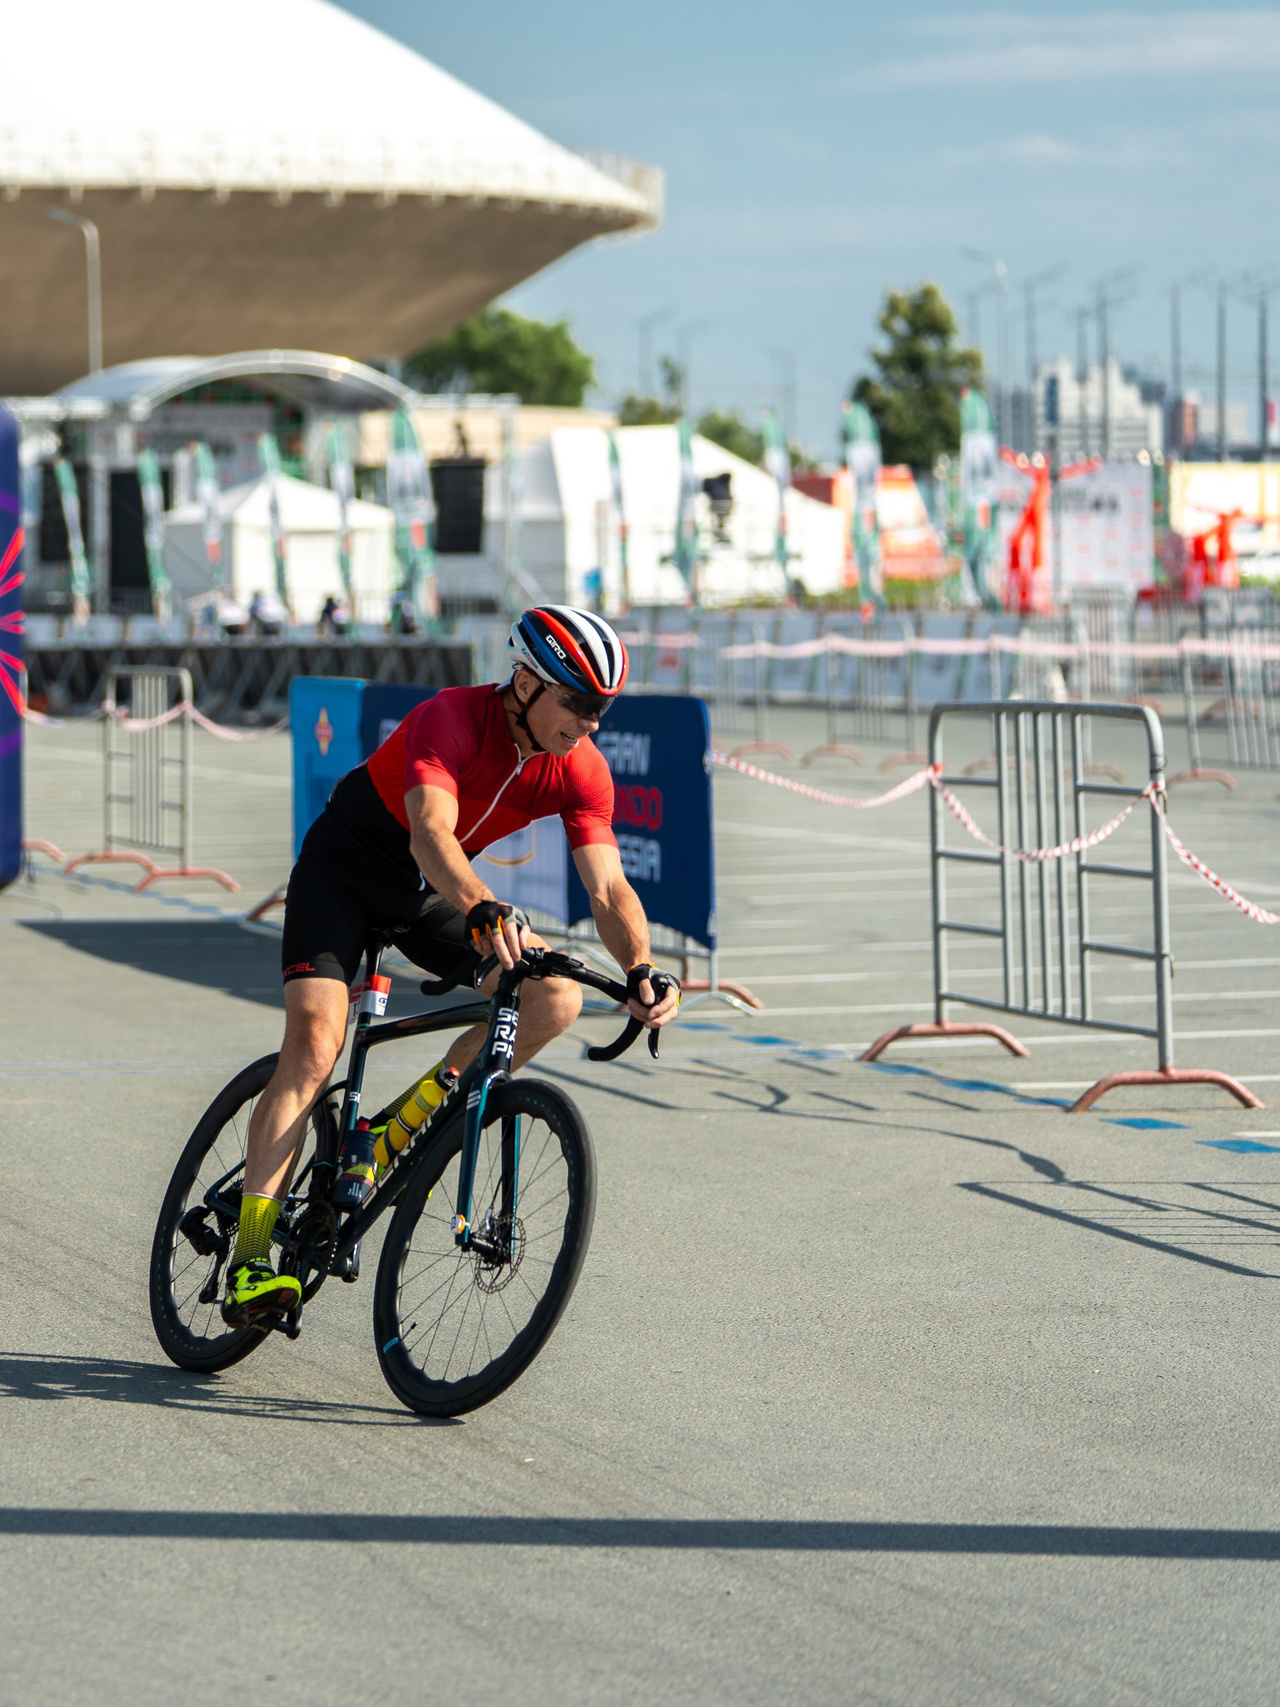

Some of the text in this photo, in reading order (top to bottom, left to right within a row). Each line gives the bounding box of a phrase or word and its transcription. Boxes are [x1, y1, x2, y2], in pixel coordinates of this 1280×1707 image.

[545, 634, 567, 660] GIRO
[613, 783, 663, 832] NDO
[617, 833, 662, 884] SSIA
